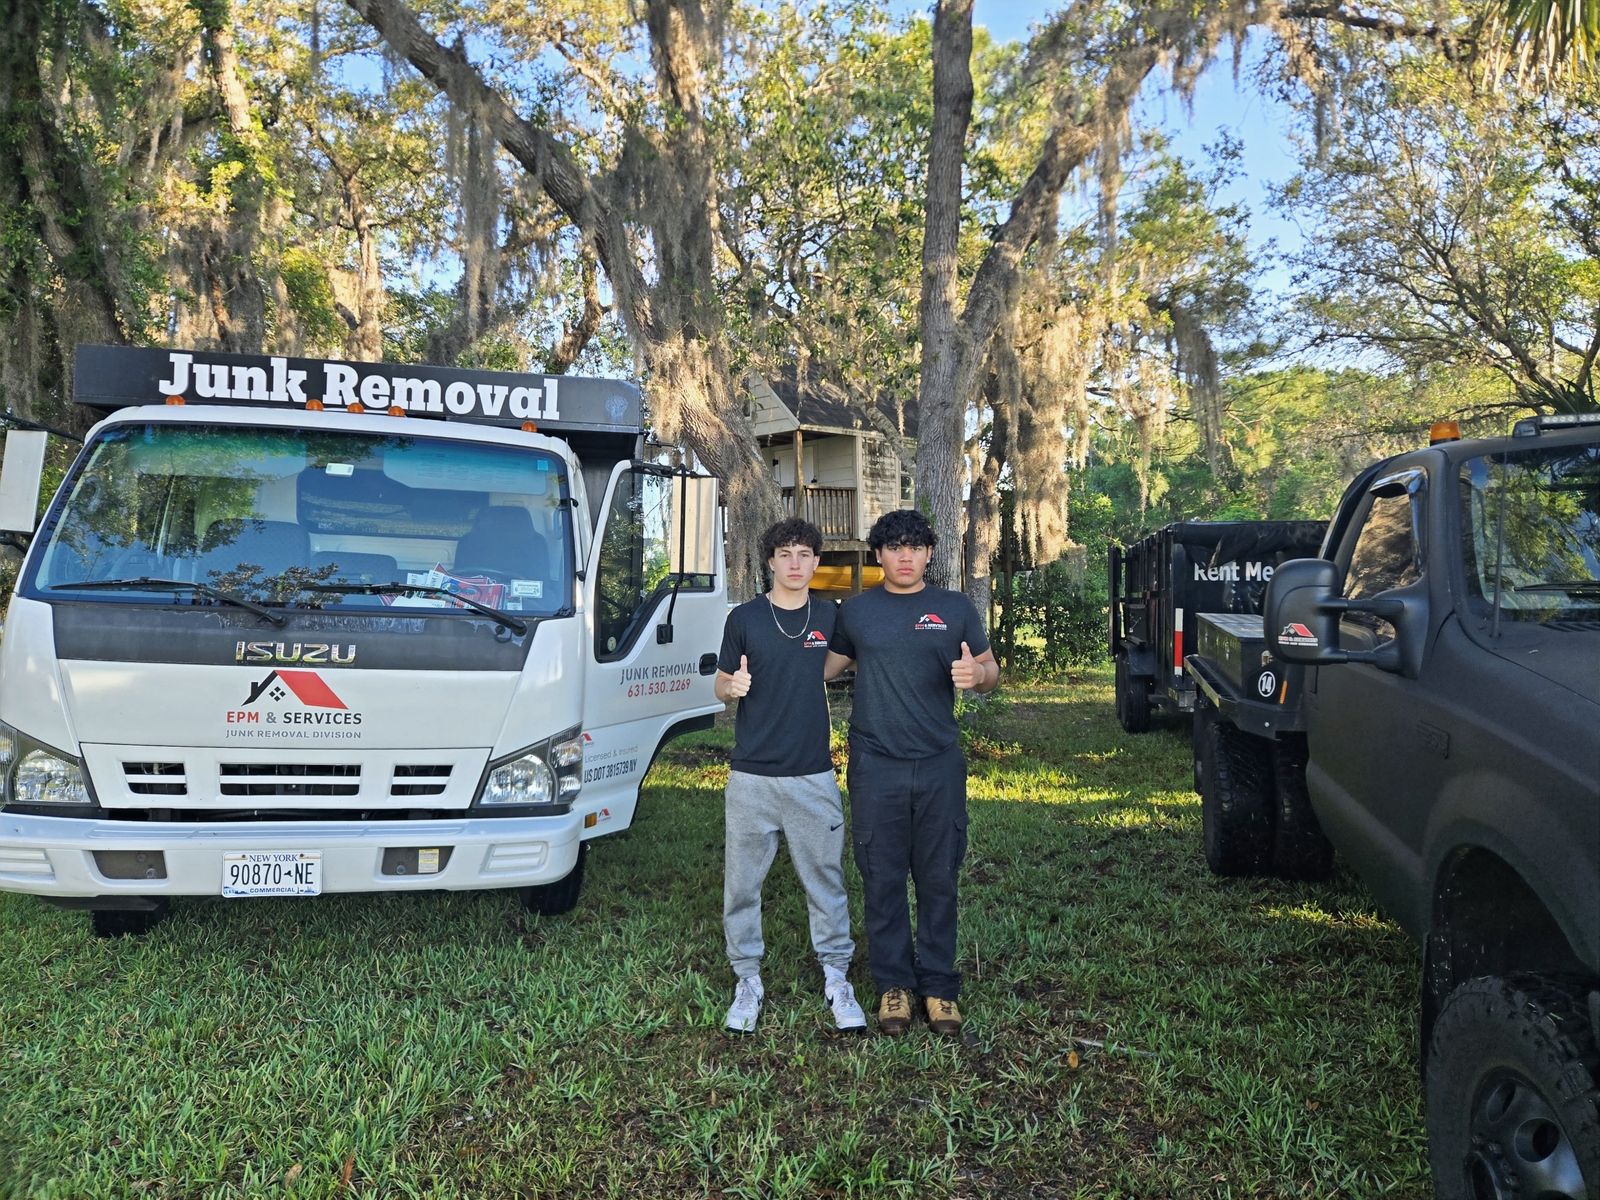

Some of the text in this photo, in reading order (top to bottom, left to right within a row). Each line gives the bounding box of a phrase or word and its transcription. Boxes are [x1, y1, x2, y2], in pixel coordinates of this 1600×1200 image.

[159, 353, 560, 420] Junk Removal
[235, 641, 356, 663] ISUZU
[620, 663, 698, 685] JUNK REMOVAL
[627, 678, 691, 698] 631.530.2269
[1261, 675, 1273, 693] 14
[226, 711, 362, 725] EPM & SERVICES
[225, 730, 361, 739] JUNK REMOVAL DIVISION
[584, 768, 593, 783] US
[593, 765, 606, 781] DOT
[273, 854, 298, 862] YORK
[230, 863, 314, 885] 90870 NE
